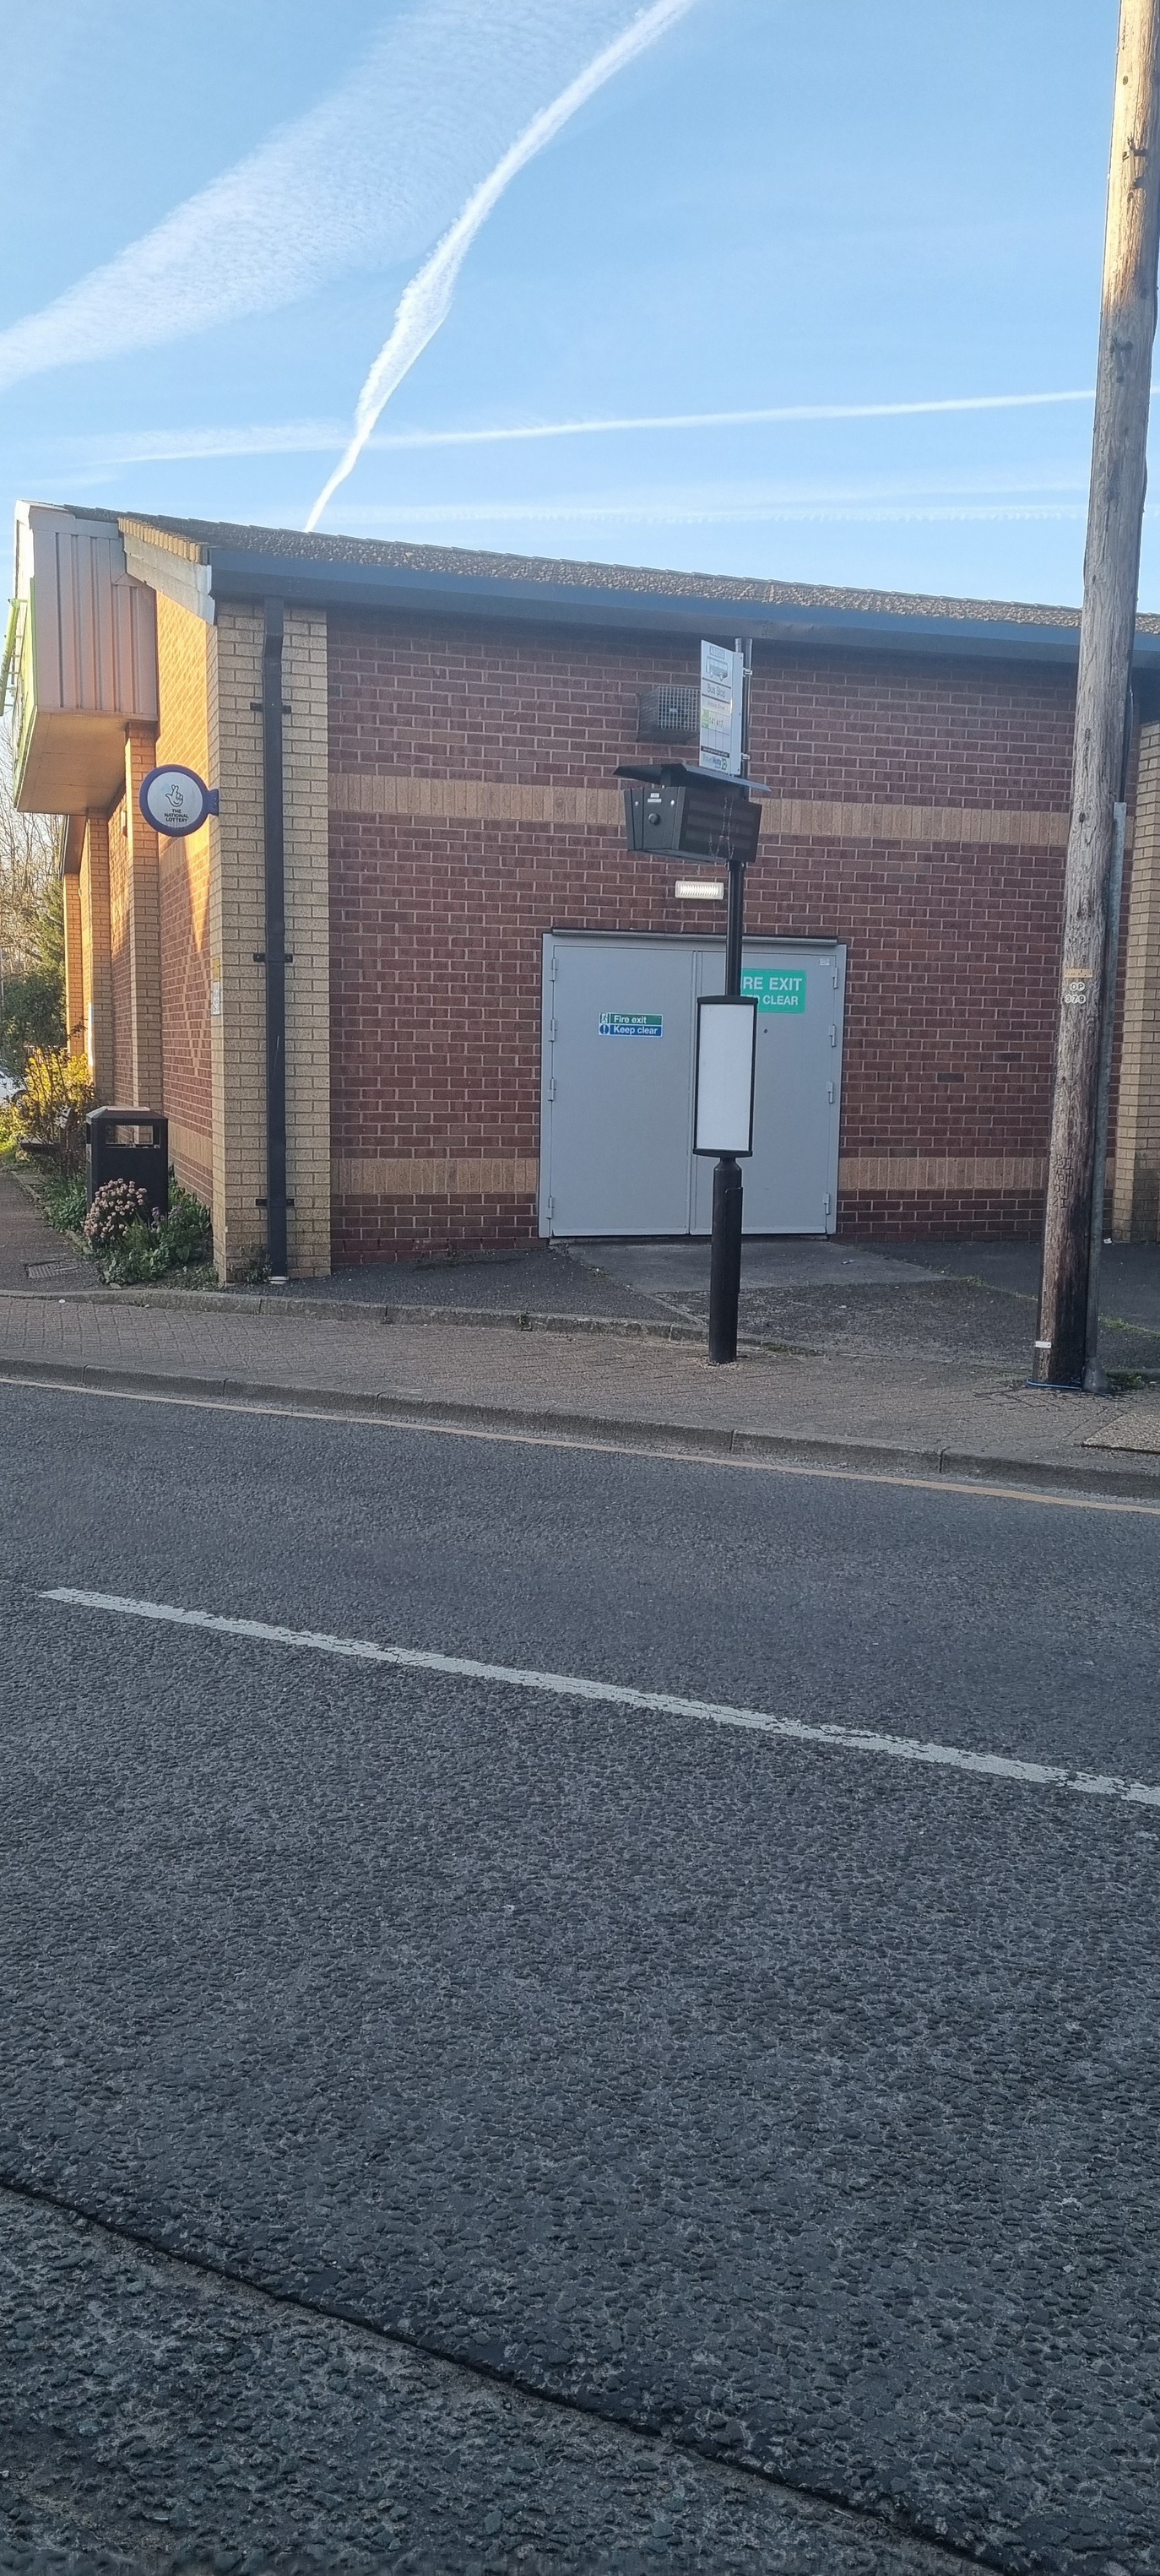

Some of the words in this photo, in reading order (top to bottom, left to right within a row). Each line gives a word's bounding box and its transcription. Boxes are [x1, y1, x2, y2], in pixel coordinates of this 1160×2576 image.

[743, 976, 763, 990] RE
[769, 977, 802, 991] EXIT
[762, 995, 799, 1006] CLEAR
[614, 1015, 630, 1023] Fire
[631, 1016, 647, 1024] exit
[613, 1025, 636, 1035] Keep
